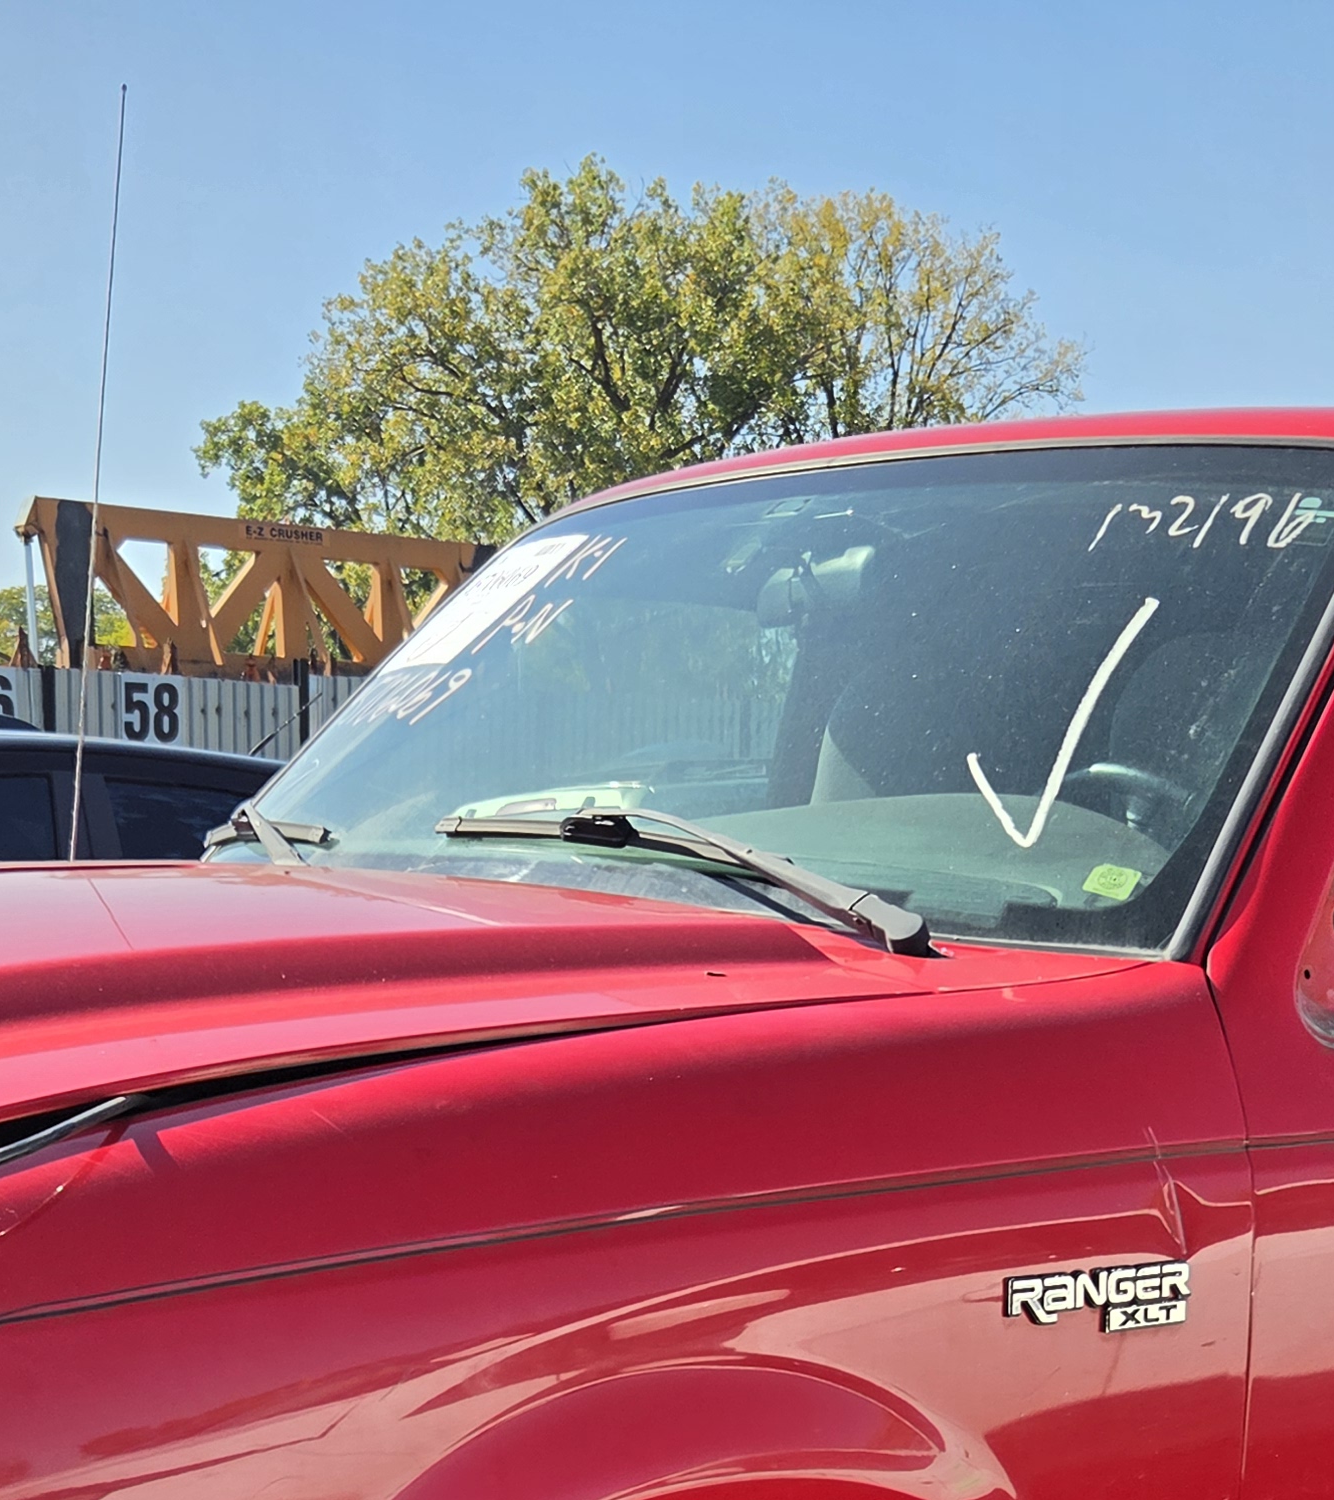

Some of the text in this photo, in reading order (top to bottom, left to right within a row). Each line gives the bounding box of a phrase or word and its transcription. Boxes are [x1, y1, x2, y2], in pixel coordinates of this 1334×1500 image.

[270, 527, 323, 542] CRUSHER
[123, 682, 180, 744] 58
[1119, 1304, 1178, 1327] XLT
